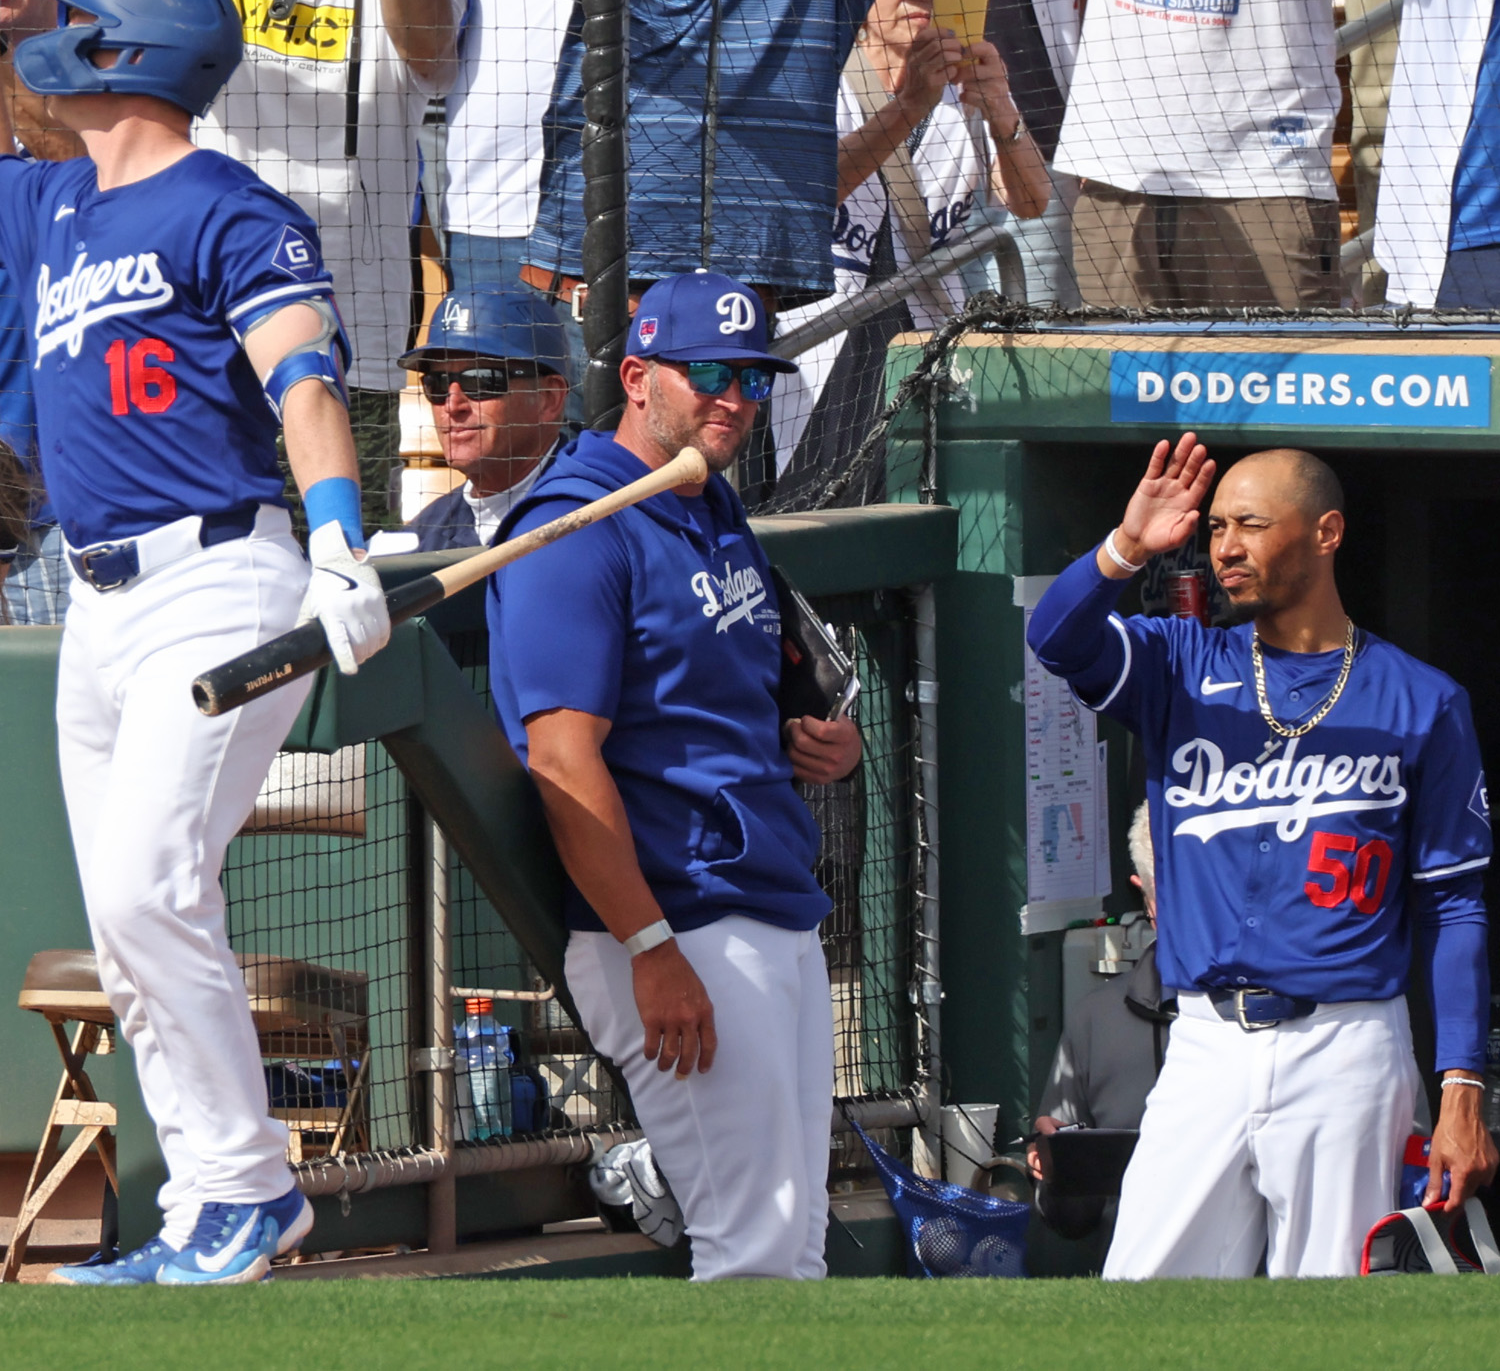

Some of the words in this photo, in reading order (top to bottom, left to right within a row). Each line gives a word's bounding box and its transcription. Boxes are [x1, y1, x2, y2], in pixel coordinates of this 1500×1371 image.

[285, 240, 308, 264] G
[716, 292, 756, 335] D
[105, 337, 178, 416] 16
[1136, 370, 1470, 408] DODGERS.COM
[1164, 736, 1407, 842] Dodgers
[1303, 830, 1393, 924] 50
